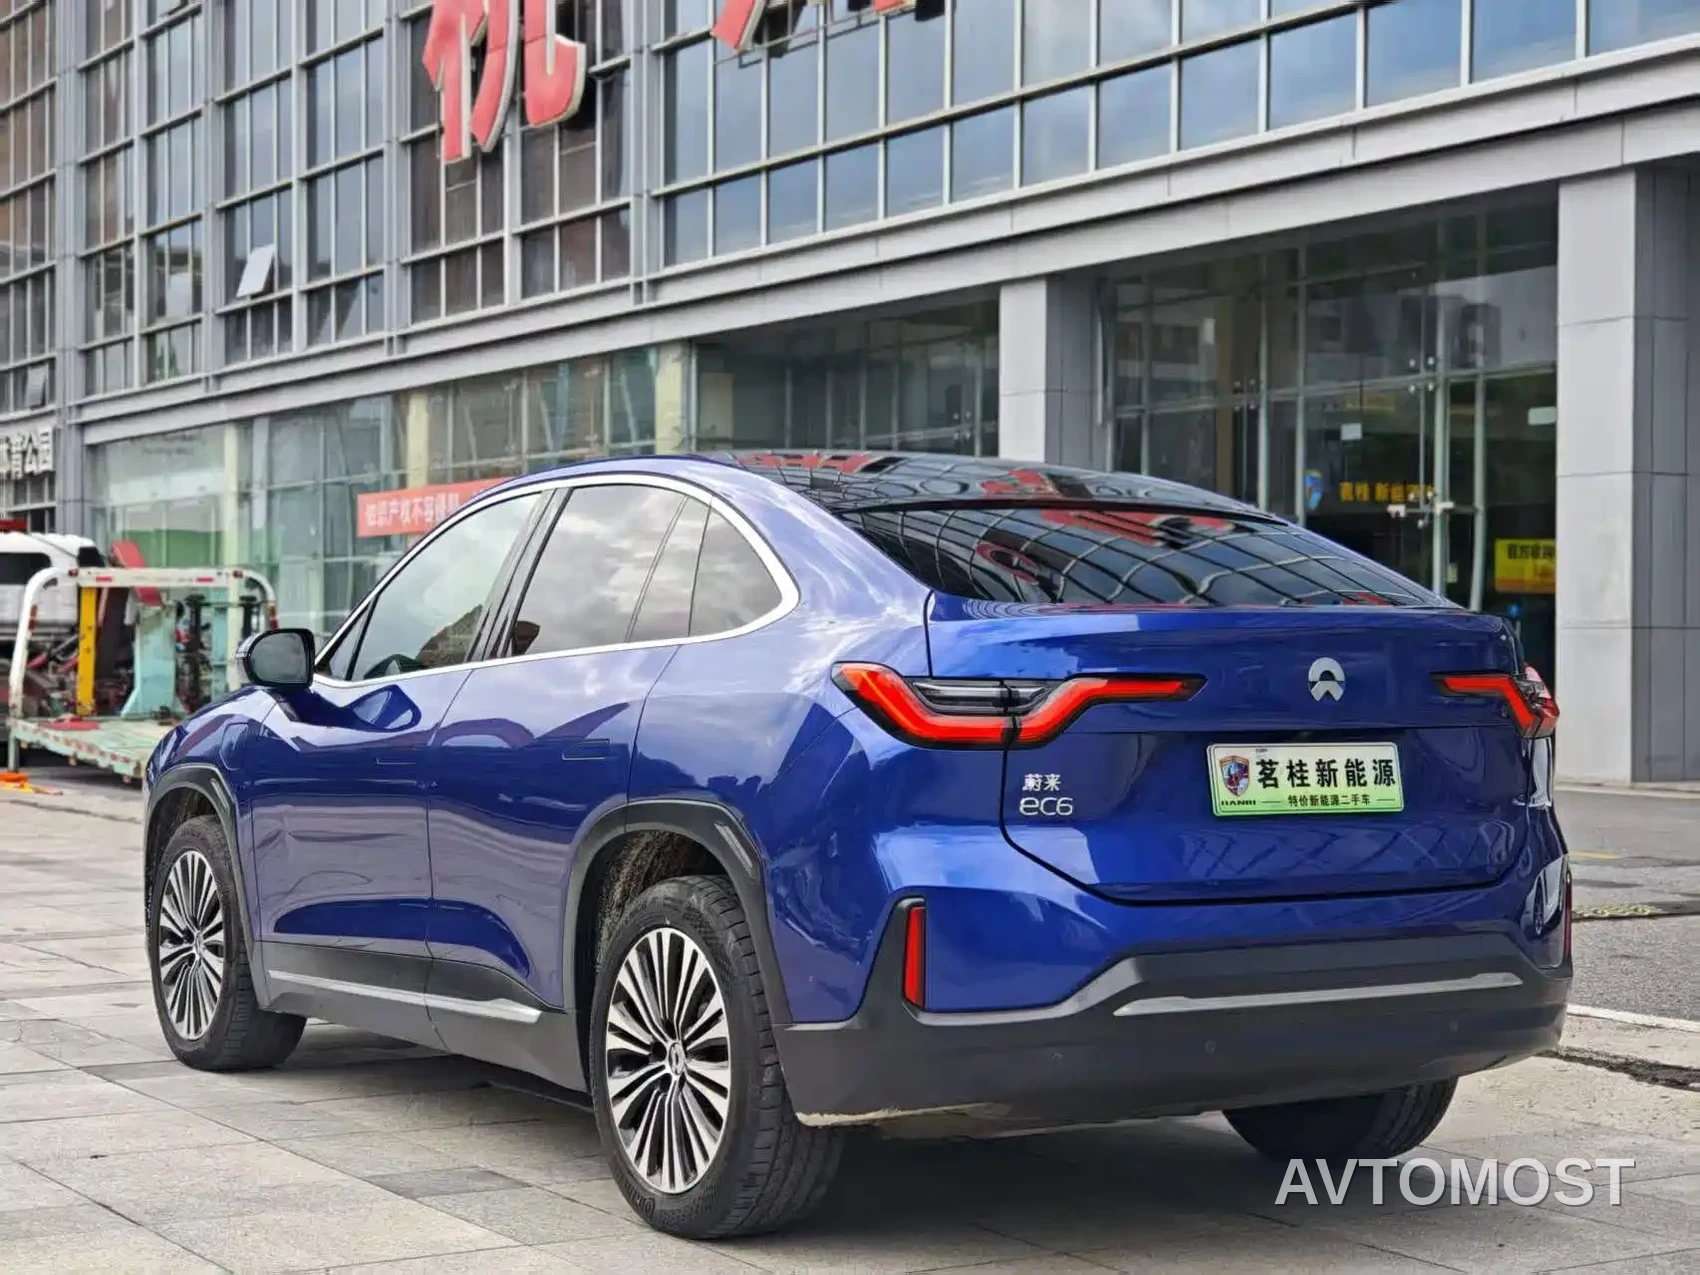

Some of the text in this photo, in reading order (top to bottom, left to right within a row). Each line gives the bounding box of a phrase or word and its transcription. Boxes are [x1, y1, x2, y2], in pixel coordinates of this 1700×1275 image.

[1022, 773, 1061, 791] 蔚来
[1256, 758, 1396, 789] 茗桂新能源
[1288, 794, 1371, 807] 特价新能源二手车
